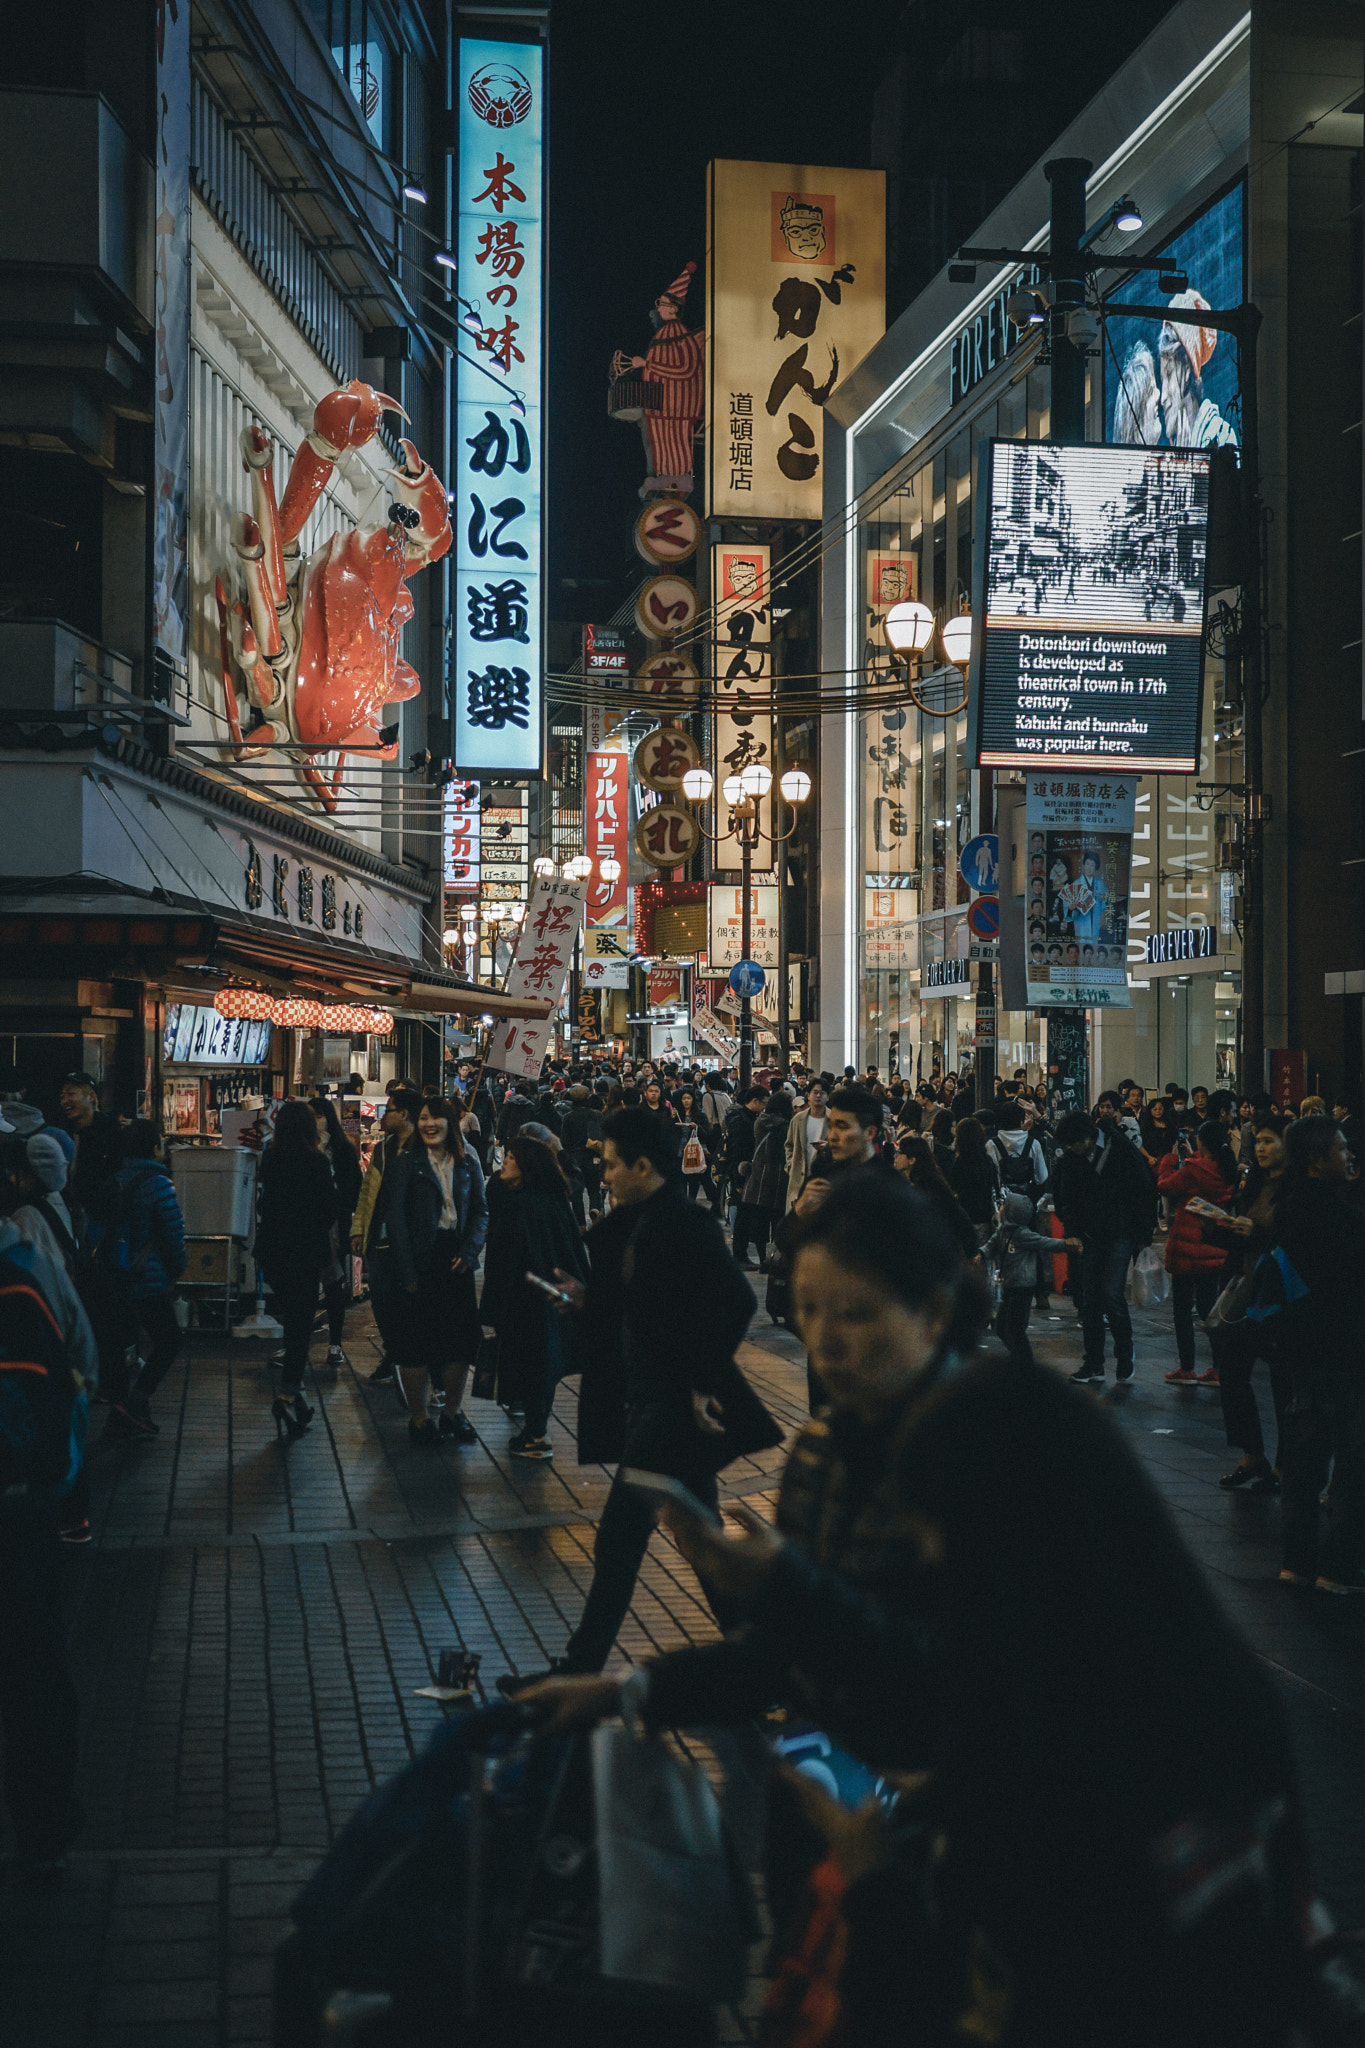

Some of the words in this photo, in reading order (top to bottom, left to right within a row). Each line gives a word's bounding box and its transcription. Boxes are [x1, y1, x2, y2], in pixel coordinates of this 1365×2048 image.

[471, 152, 527, 373] 本場の味
[765, 264, 857, 481] がんこ
[729, 392, 753, 492] 道頓堀店
[1019, 634, 1090, 652] Dotonbori
[1093, 637, 1167, 655] downtown
[590, 656, 626, 667] 3F/4F
[1019, 653, 1031, 669] is
[1033, 655, 1106, 675] developed
[1108, 660, 1124, 672] as
[1017, 673, 1081, 692] theatrical
[1084, 678, 1118, 693] town
[1120, 677, 1134, 692] in
[1138, 677, 1167, 694] 17th
[1017, 695, 1072, 712] century.
[591, 721, 599, 749] SHOP
[724, 602, 771, 849] がんこ寿
[1015, 714, 1062, 731] Kabuki
[1064, 717, 1090, 731] and
[1092, 717, 1148, 734] bunraku
[1016, 737, 1042, 750] was
[1045, 736, 1097, 753] popular
[1099, 736, 1133, 751] here.
[1033, 781, 1129, 800] 道頓堀商店会
[595, 757, 619, 904] ツルハドラグ
[723, 950, 774, 963] 寿司和食
[1146, 930, 1195, 964] FOREVER
[1199, 927, 1212, 957] 21
[504, 897, 574, 1057] 松葉に
[651, 970, 680, 980] ツルハ
[926, 961, 956, 987] FOREVER
[957, 959, 966, 982] 21
